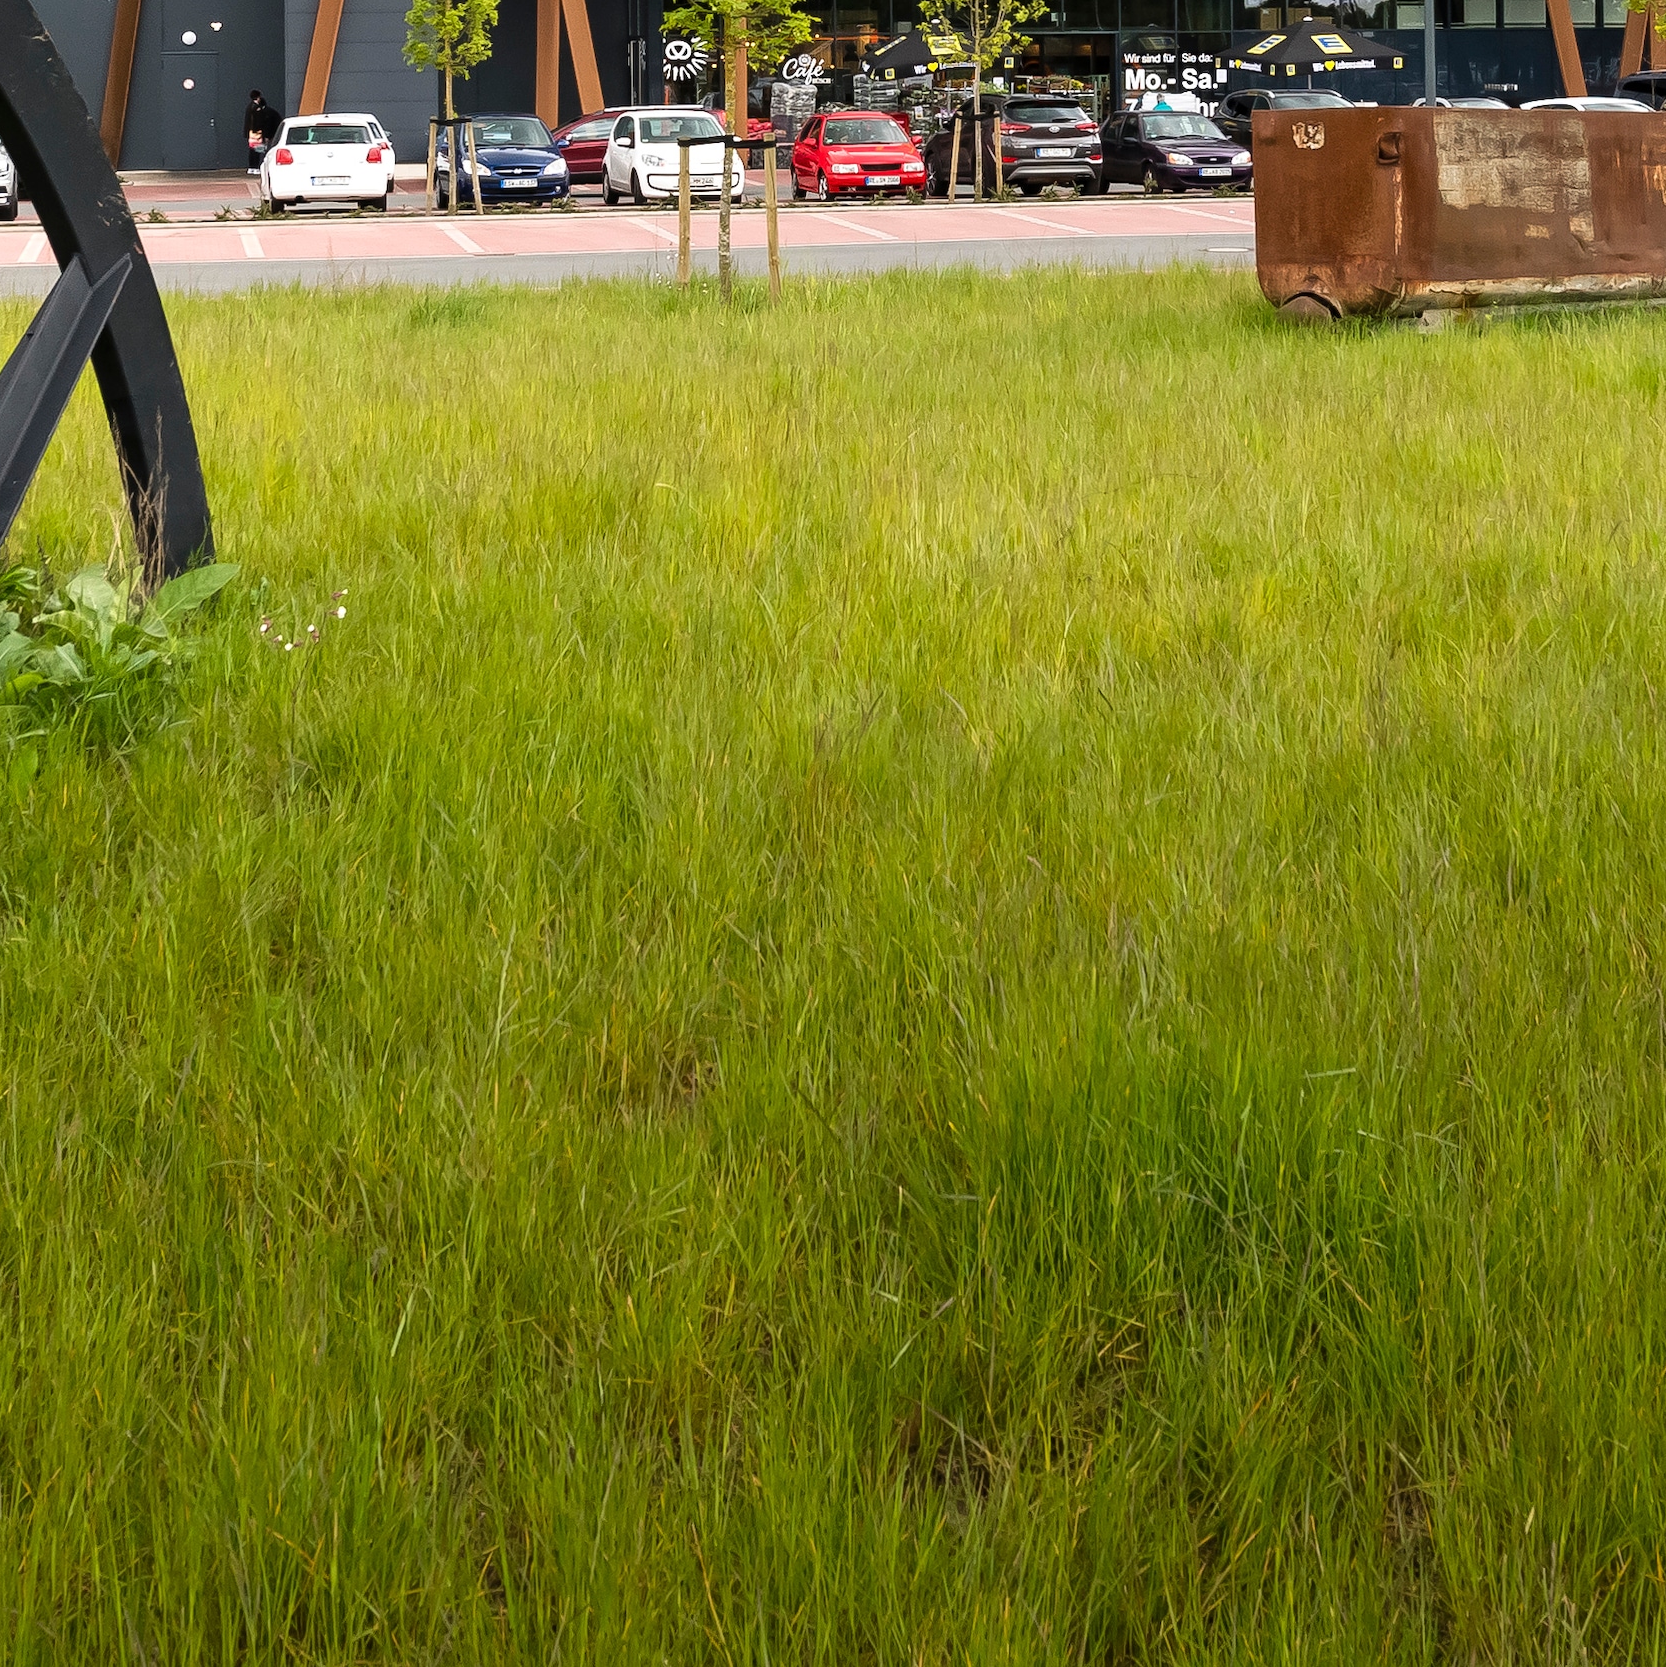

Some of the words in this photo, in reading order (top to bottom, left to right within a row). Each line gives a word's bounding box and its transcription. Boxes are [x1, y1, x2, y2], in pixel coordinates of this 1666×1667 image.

[1123, 53, 1141, 64] Wir
[1141, 53, 1161, 64] sind
[1162, 53, 1176, 64] für
[1181, 52, 1197, 63] Sie
[1198, 52, 1213, 63] da:
[782, 56, 825, 86] Café
[1181, 67, 1219, 90] Sa.
